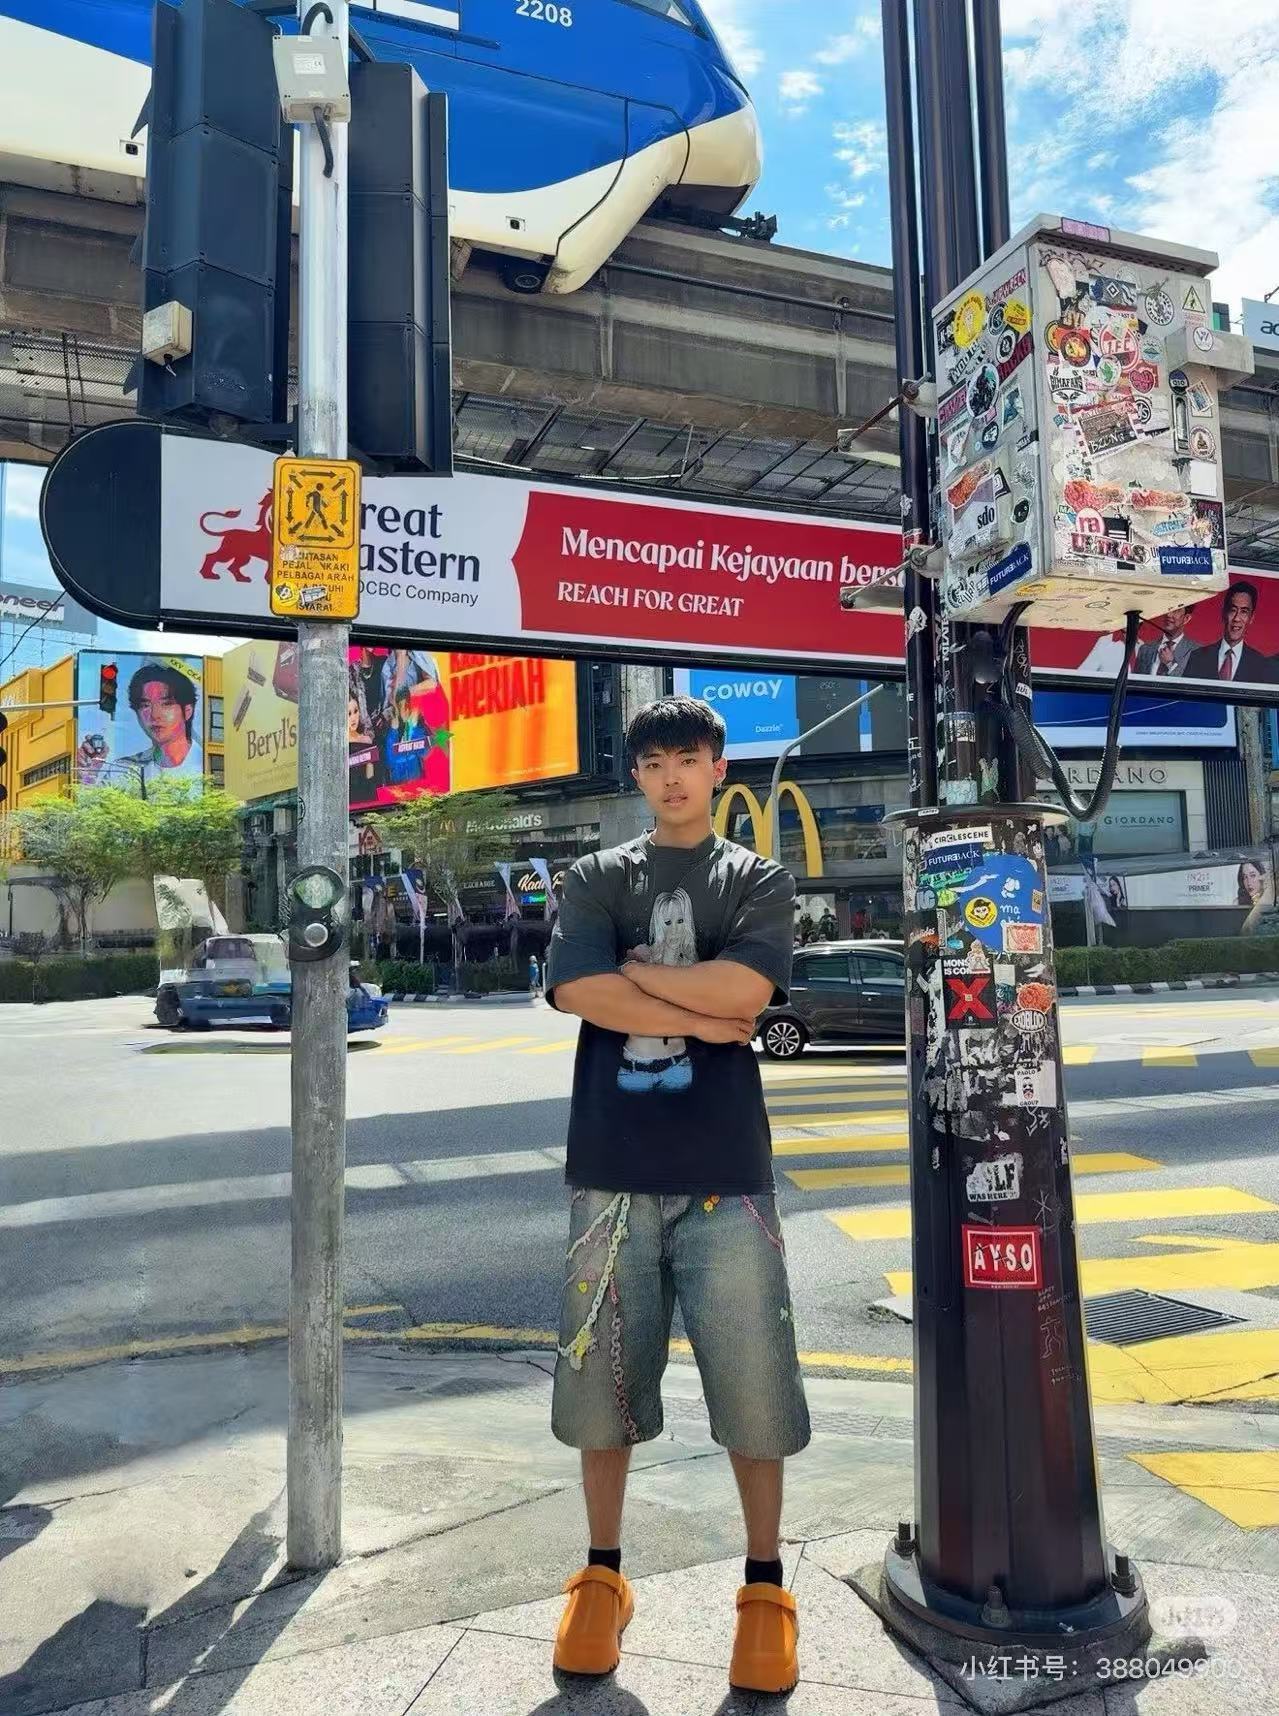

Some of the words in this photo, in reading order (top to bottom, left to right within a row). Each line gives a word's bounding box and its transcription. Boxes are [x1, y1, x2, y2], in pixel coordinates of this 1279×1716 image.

[515, 0, 573, 28] 2208
[361, 503, 443, 539] reat
[360, 541, 480, 582] astern
[561, 526, 704, 571] Mencapai
[710, 544, 833, 583] Kejayaan
[277, 570, 324, 581] PELBAGAI
[327, 573, 355, 582] ARAH
[406, 585, 479, 608] Company
[557, 581, 629, 608] REACH
[633, 588, 673, 611] FOR
[678, 595, 744, 618] GREAT
[450, 657, 545, 722] MERIAH
[703, 678, 783, 702] coway
[246, 716, 298, 763] Beryl's
[1103, 815, 1175, 826] GIORDANO
[974, 1242, 1033, 1272] AYSO
